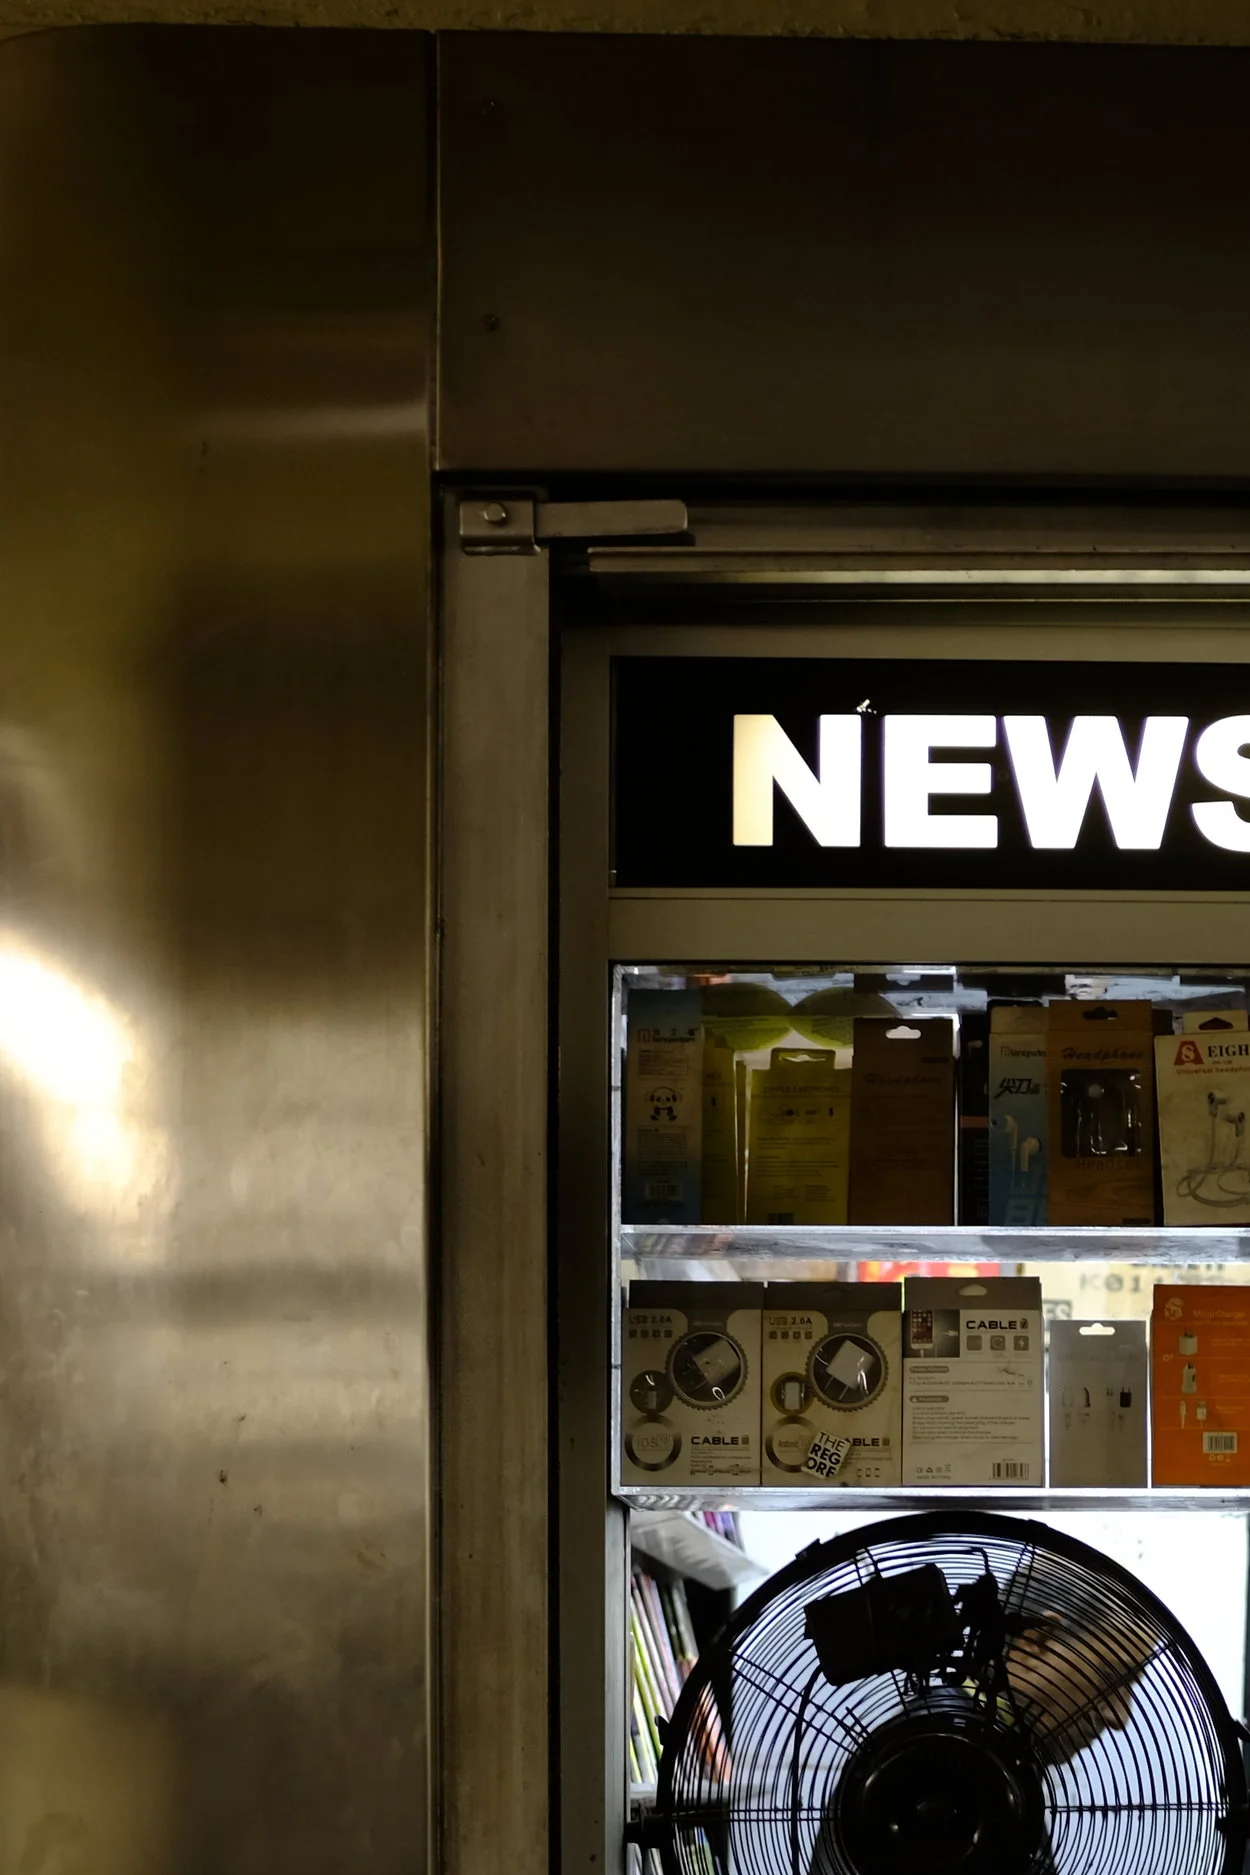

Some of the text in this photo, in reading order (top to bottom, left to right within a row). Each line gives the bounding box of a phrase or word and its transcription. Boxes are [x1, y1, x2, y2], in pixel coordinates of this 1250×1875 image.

[966, 1320, 1018, 1330] CABLE
[691, 1436, 739, 1445] CABLE
[819, 1431, 844, 1452] THE
[810, 1444, 841, 1465] REG
